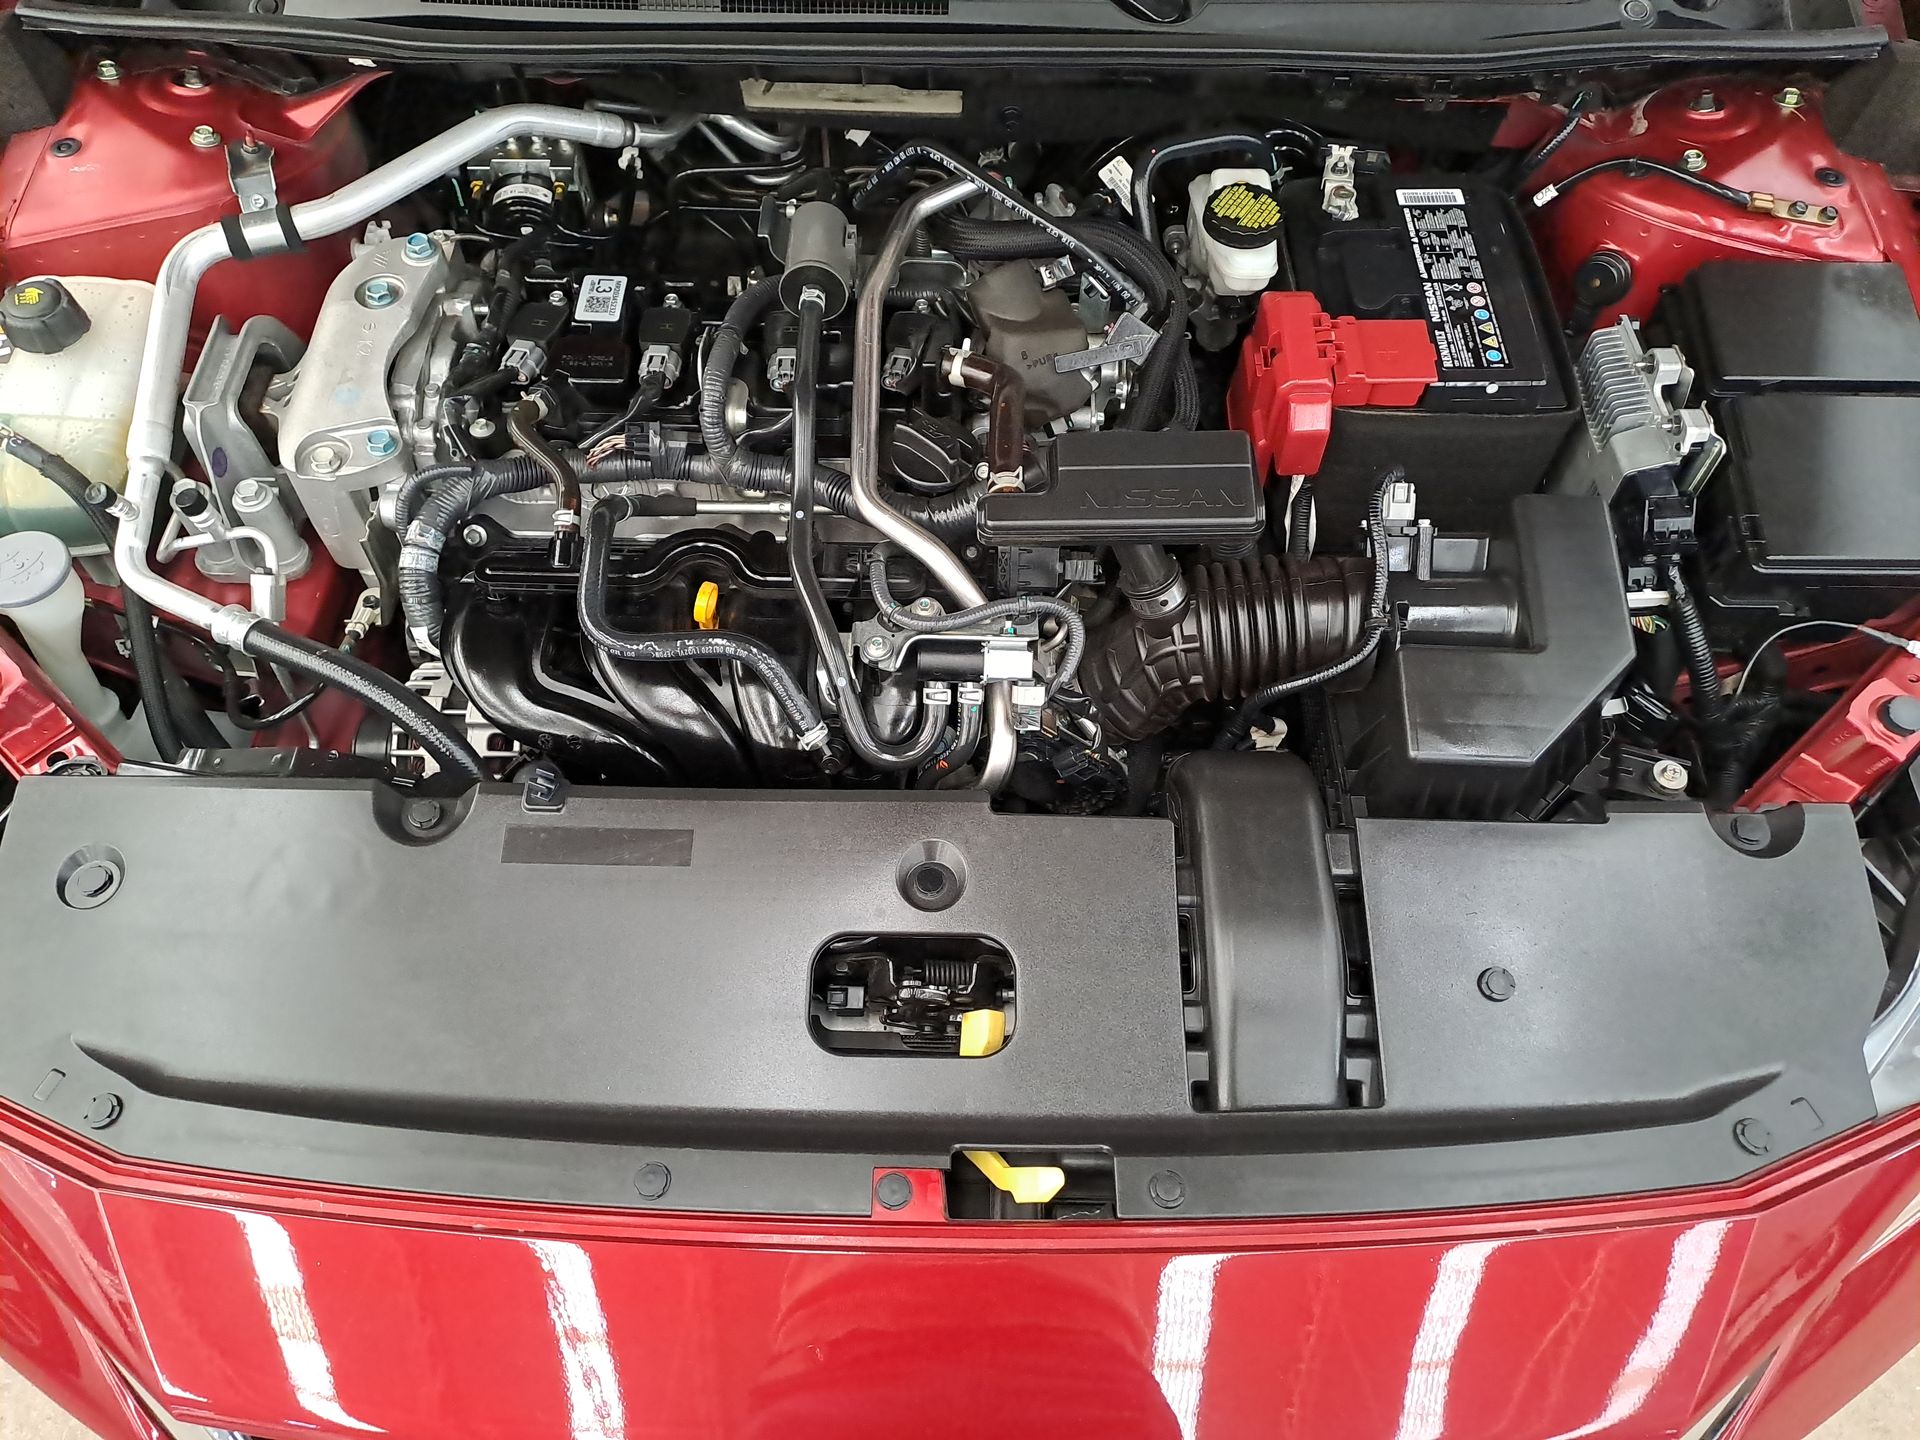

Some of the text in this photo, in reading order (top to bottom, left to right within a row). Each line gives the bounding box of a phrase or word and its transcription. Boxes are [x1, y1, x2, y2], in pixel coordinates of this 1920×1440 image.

[595, 278, 614, 294] L3
[1422, 282, 1442, 323] NISSAN
[1435, 329, 1454, 368] RENAULT
[1080, 488, 1246, 509] NISSAN
